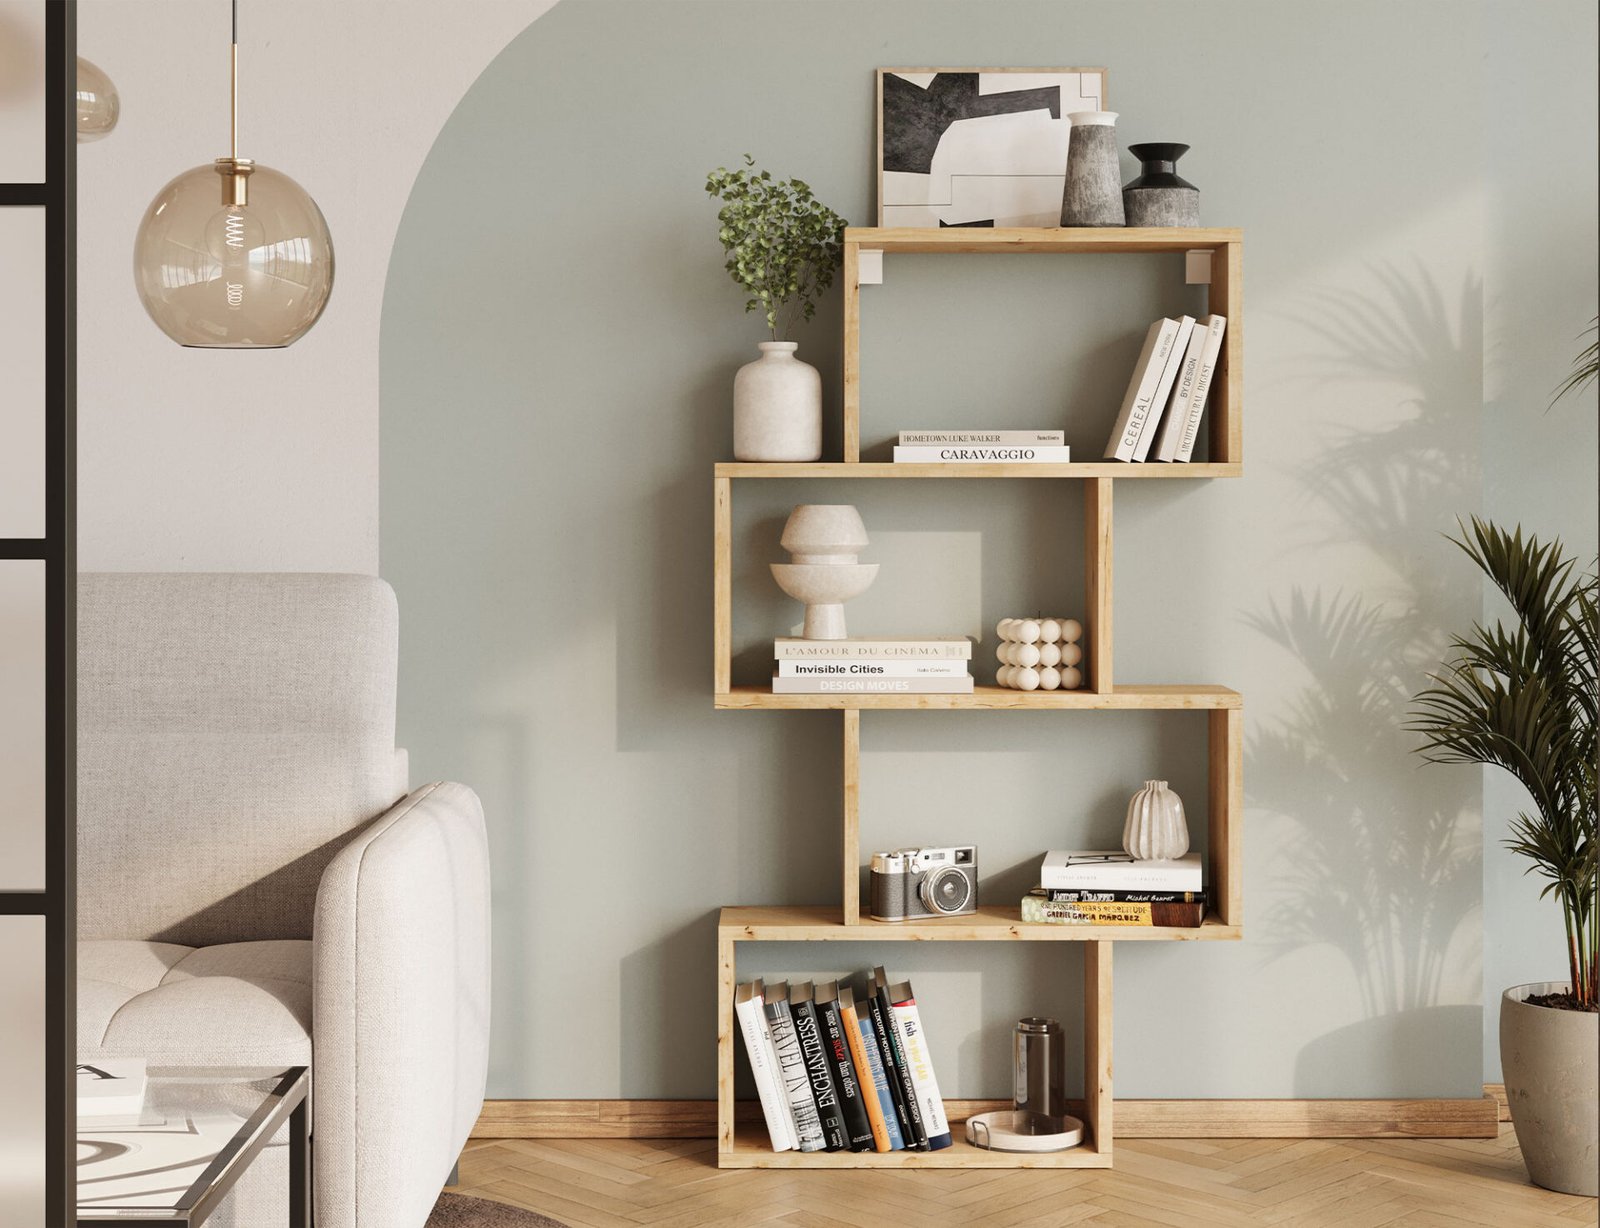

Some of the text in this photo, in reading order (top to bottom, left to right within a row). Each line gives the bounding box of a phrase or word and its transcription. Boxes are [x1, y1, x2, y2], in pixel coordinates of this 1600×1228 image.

[1180, 358, 1197, 398] BY DESIGN
[1181, 364, 1211, 453] ARCHITECTURAL DIGEST
[1124, 397, 1150, 447] CEREAL
[940, 449, 1035, 460] CARAVAGGIO
[785, 647, 849, 655] L'AMOUR
[858, 647, 878, 655] DU
[795, 664, 884, 674] Invisible Cities
[820, 680, 909, 691] DESIGN MOVES
[886, 1006, 899, 1033] STEPHEN
[904, 1020, 917, 1037] fish
[873, 1008, 893, 1067] LUXURY HOUSES
[893, 1032, 907, 1065] HAWKING
[797, 1016, 836, 1109] ENCHANTRESS
[825, 1010, 856, 1098] some are sicker than others
[899, 1065, 908, 1078] THE
[786, 1075, 810, 1093] IN
[903, 1077, 914, 1100] GRAND
[909, 1100, 921, 1123] DESIGN
